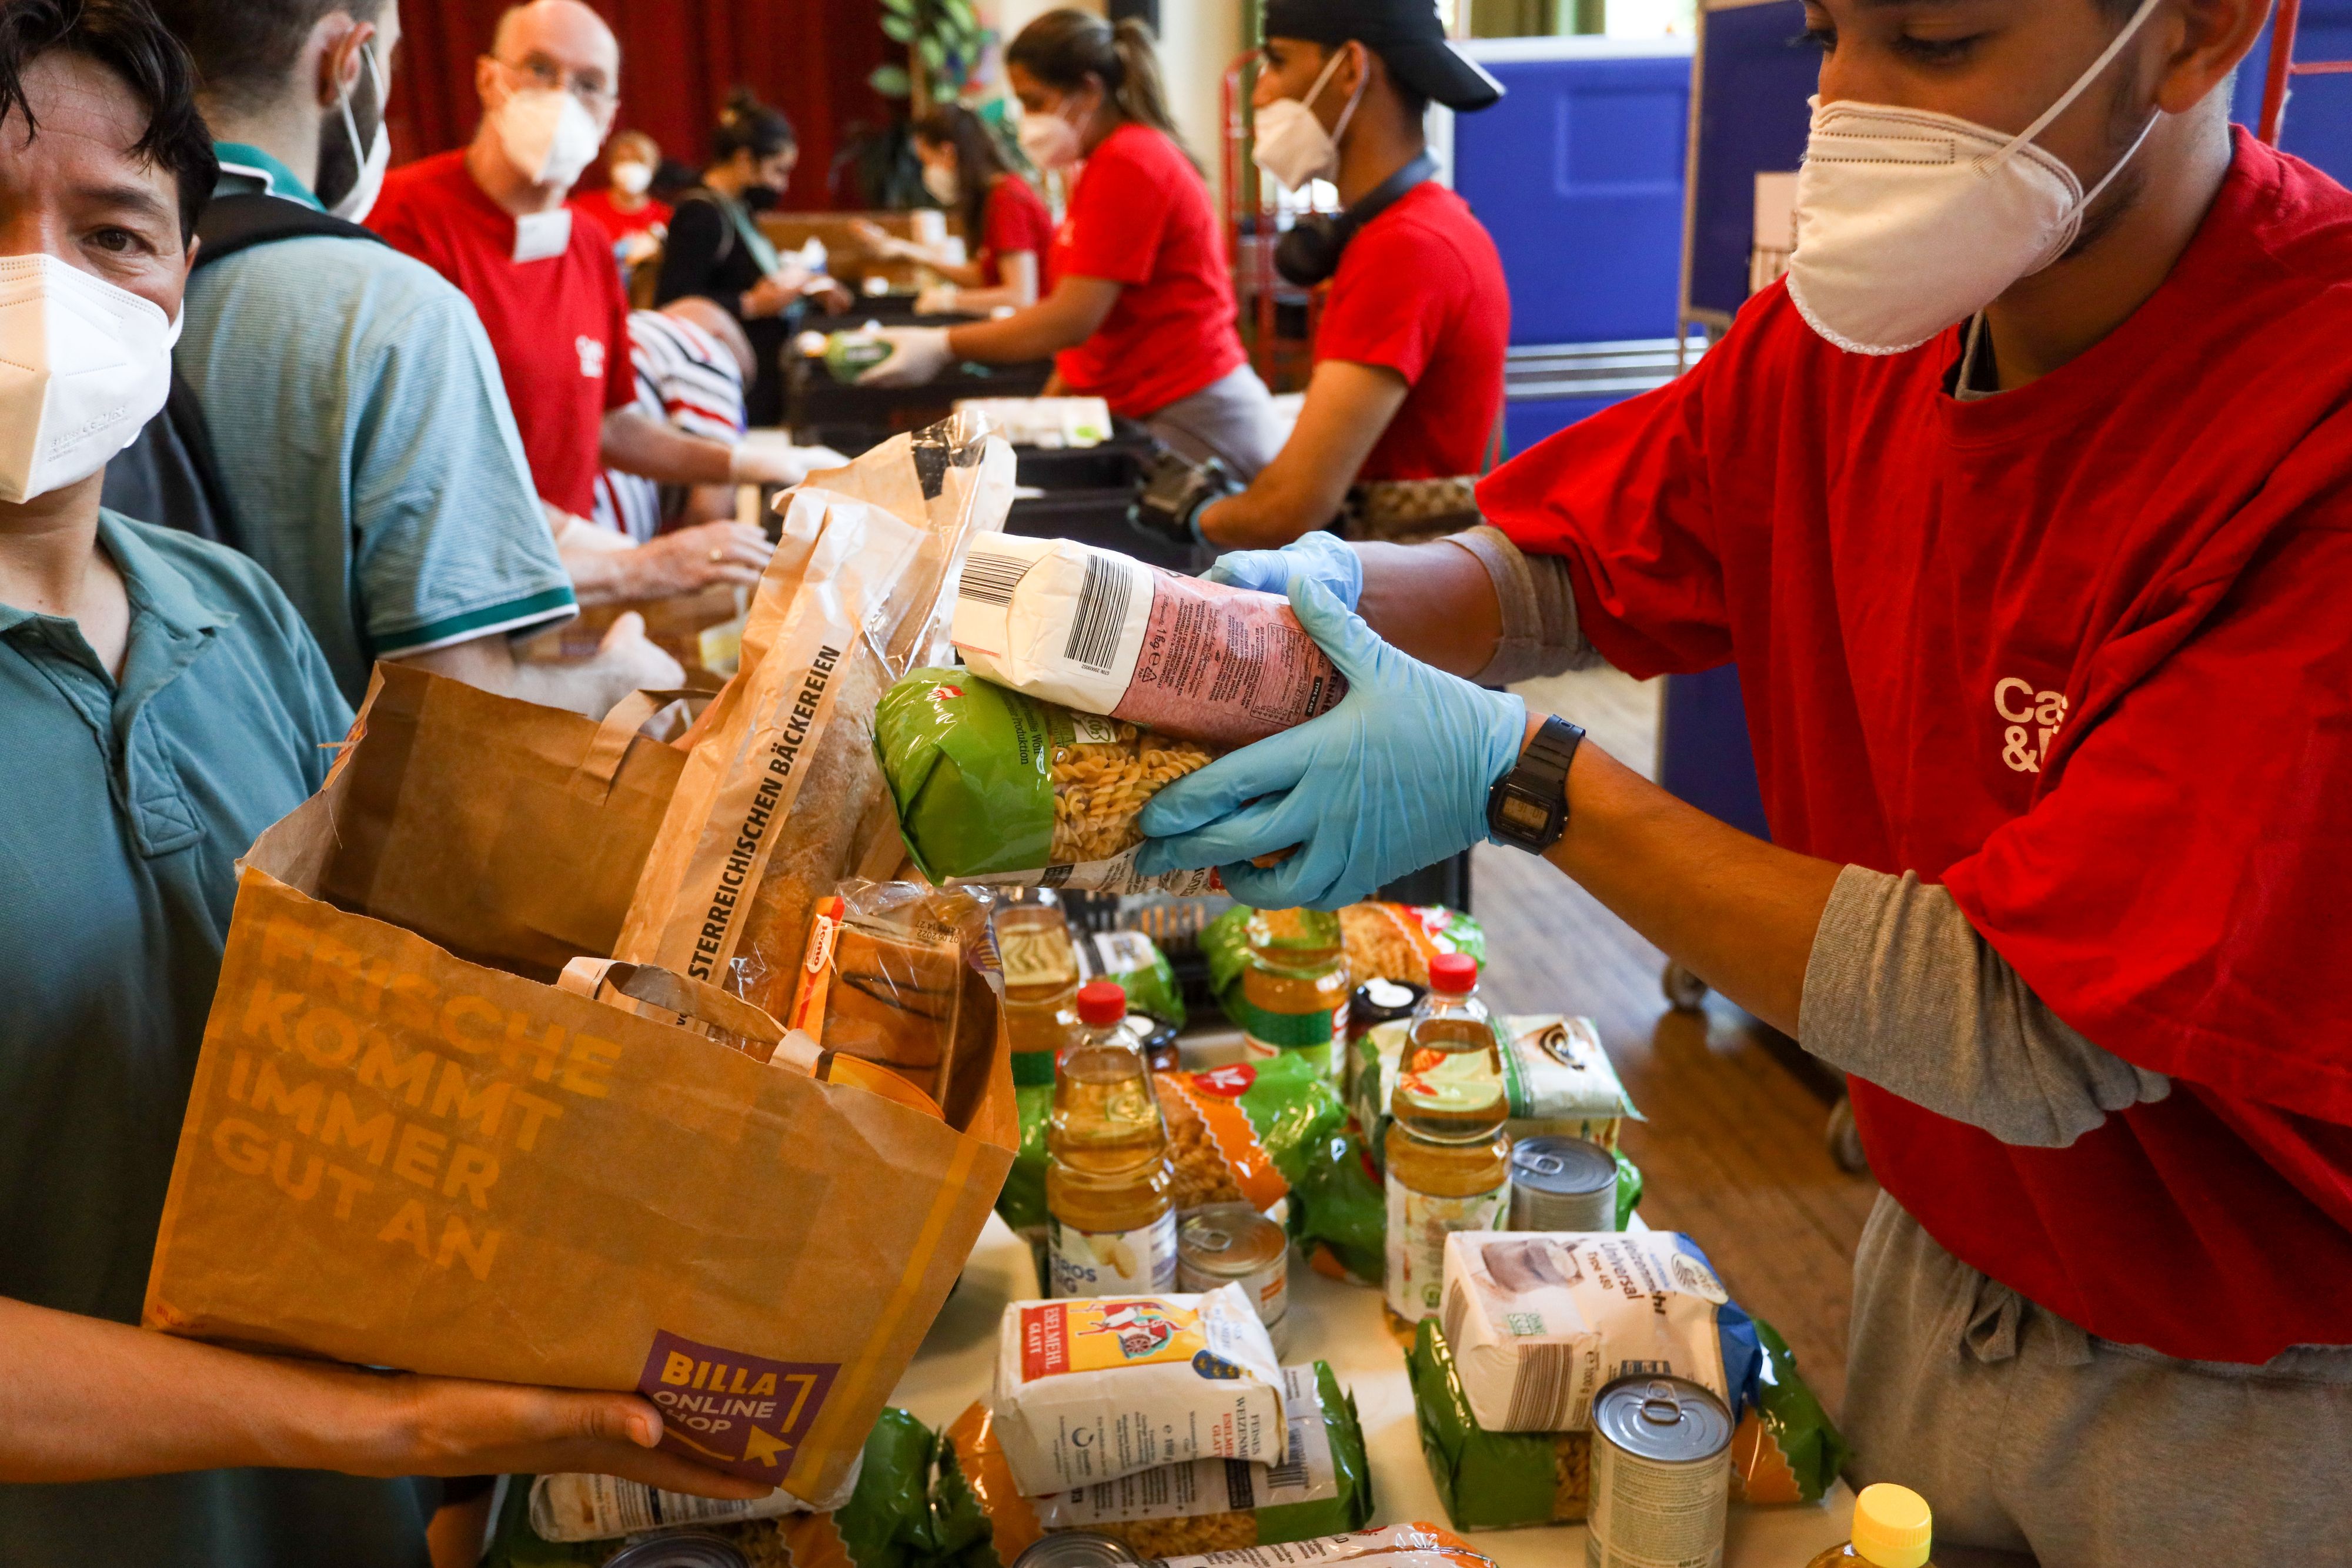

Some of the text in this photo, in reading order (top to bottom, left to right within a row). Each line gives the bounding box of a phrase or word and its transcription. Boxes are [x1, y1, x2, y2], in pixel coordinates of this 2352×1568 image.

[1174, 597, 1184, 632] SCHMIDGASSE
[1179, 604, 1188, 635] GOODMILLS
[1183, 603, 1194, 636] HERGESTELLT
[1197, 600, 1206, 633] UNGEÖFFNET
[1148, 633, 1167, 651] kg
[1166, 642, 1175, 659] A-2320
[1168, 636, 1183, 667] ÖSTERREICH
[1188, 633, 1200, 665] MINDESTENS
[1232, 638, 1244, 678] AUSTROCKNUNG
[1249, 636, 1259, 681] NATURPRODUKTEN
[1156, 659, 1170, 688] SCHWECHAT
[1171, 644, 1186, 675] ÖSTERREICH
[1174, 635, 1195, 690] PACKUNGSOBERSEITE.
[1216, 638, 1230, 681] DURCHGEBACKEN
[1224, 647, 1234, 671] BESTIMMT
[1231, 650, 1249, 700] GEWICHTSABNAHME
[1167, 675, 1175, 688] VON:
[1180, 665, 1191, 687] HALTBAR
[1213, 682, 1224, 701] MÜSSEN
[1223, 674, 1231, 689] NICHT
[1224, 679, 1236, 704] MÖGLICH.
[1248, 665, 1261, 698] UNTERLIEGEN
[1240, 681, 1252, 706] ÜBLICHEN
[1994, 677, 2069, 726] Ca
[1013, 715, 1029, 765] Produktion
[689, 644, 841, 981] STERREICHISCHEN BÄCKEREIEN
[260, 911, 623, 1099] FRISCHE
[240, 979, 564, 1152] KOMMT
[226, 1050, 500, 1211] IMMER
[211, 1118, 503, 1282] GUT AN
[1599, 1241, 1645, 1300] Universal
[1029, 1322, 1041, 1355] GLATT
[1044, 1307, 1063, 1370] ESELMEHL
[660, 1350, 779, 1396] BILLA
[653, 1390, 777, 1419] ONLINE
[667, 1409, 733, 1435] HOP
[1250, 1413, 1262, 1457] FEINES
